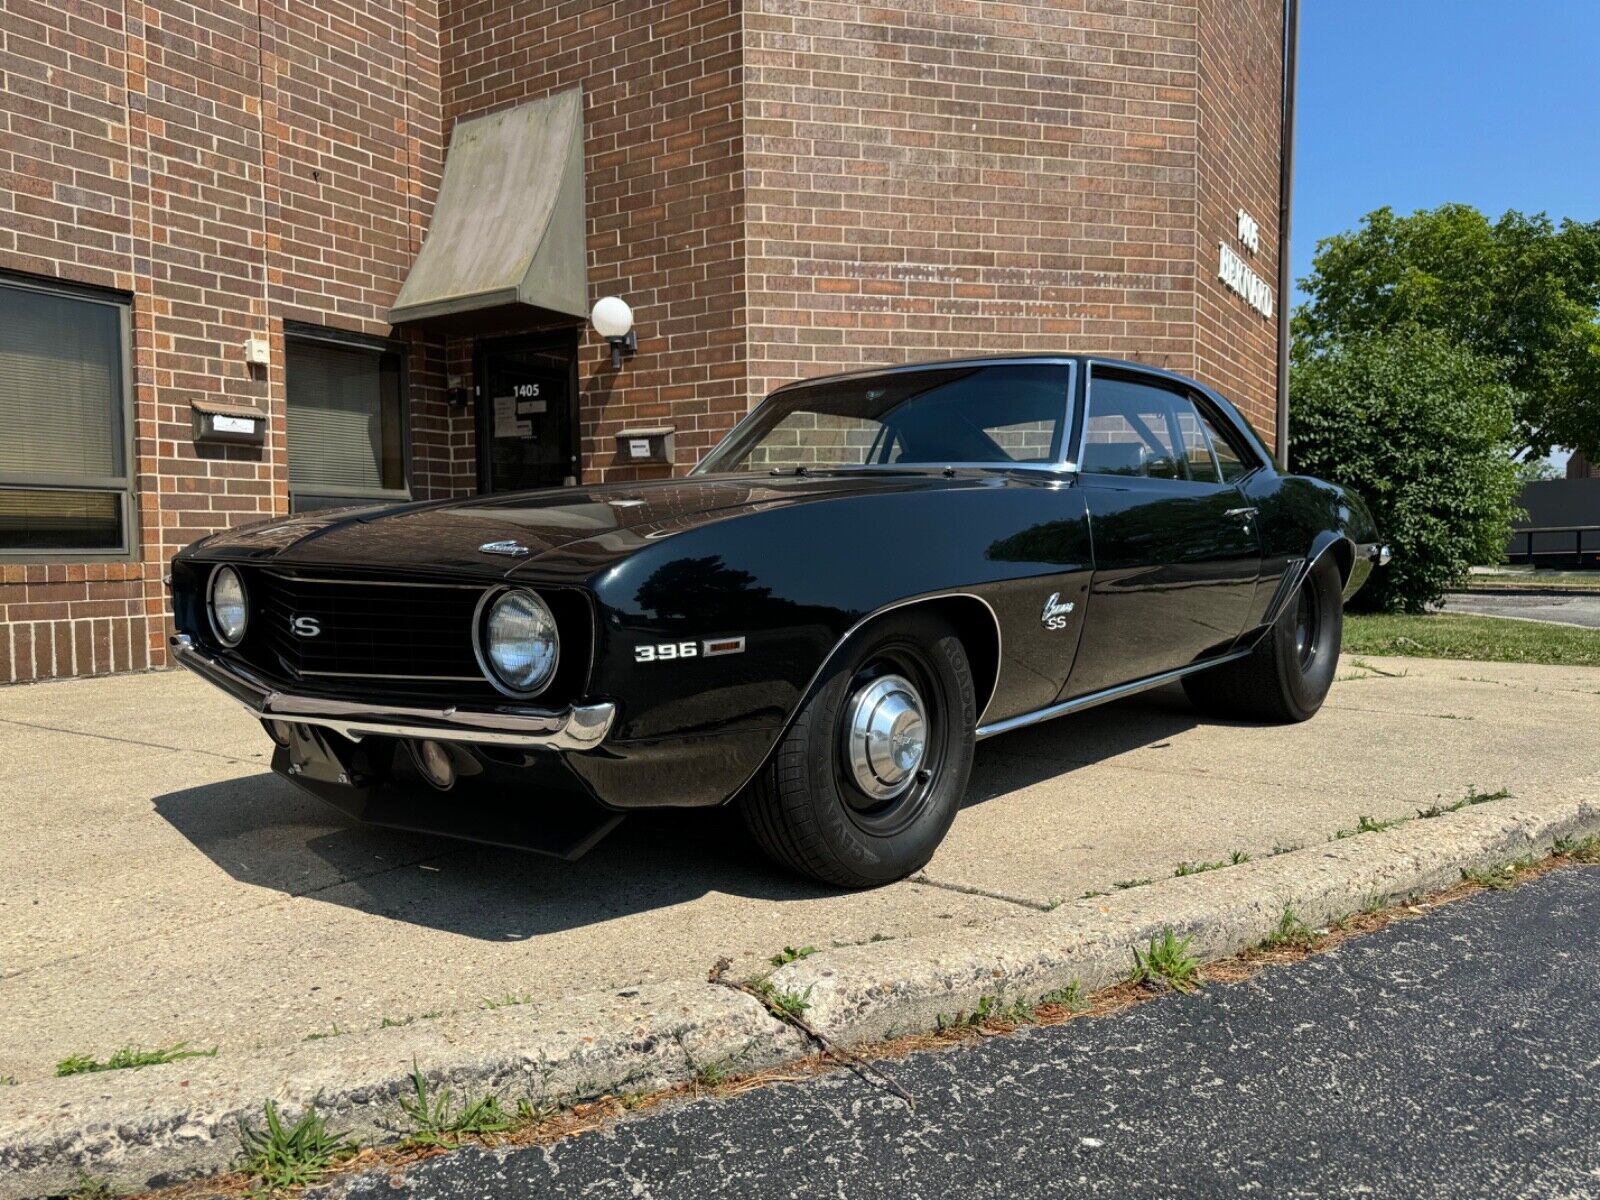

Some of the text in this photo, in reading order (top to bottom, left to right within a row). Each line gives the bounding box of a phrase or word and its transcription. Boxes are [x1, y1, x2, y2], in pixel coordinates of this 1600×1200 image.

[513, 383, 540, 398] 1405
[1046, 615, 1067, 630] SS
[634, 640, 698, 663] 396
